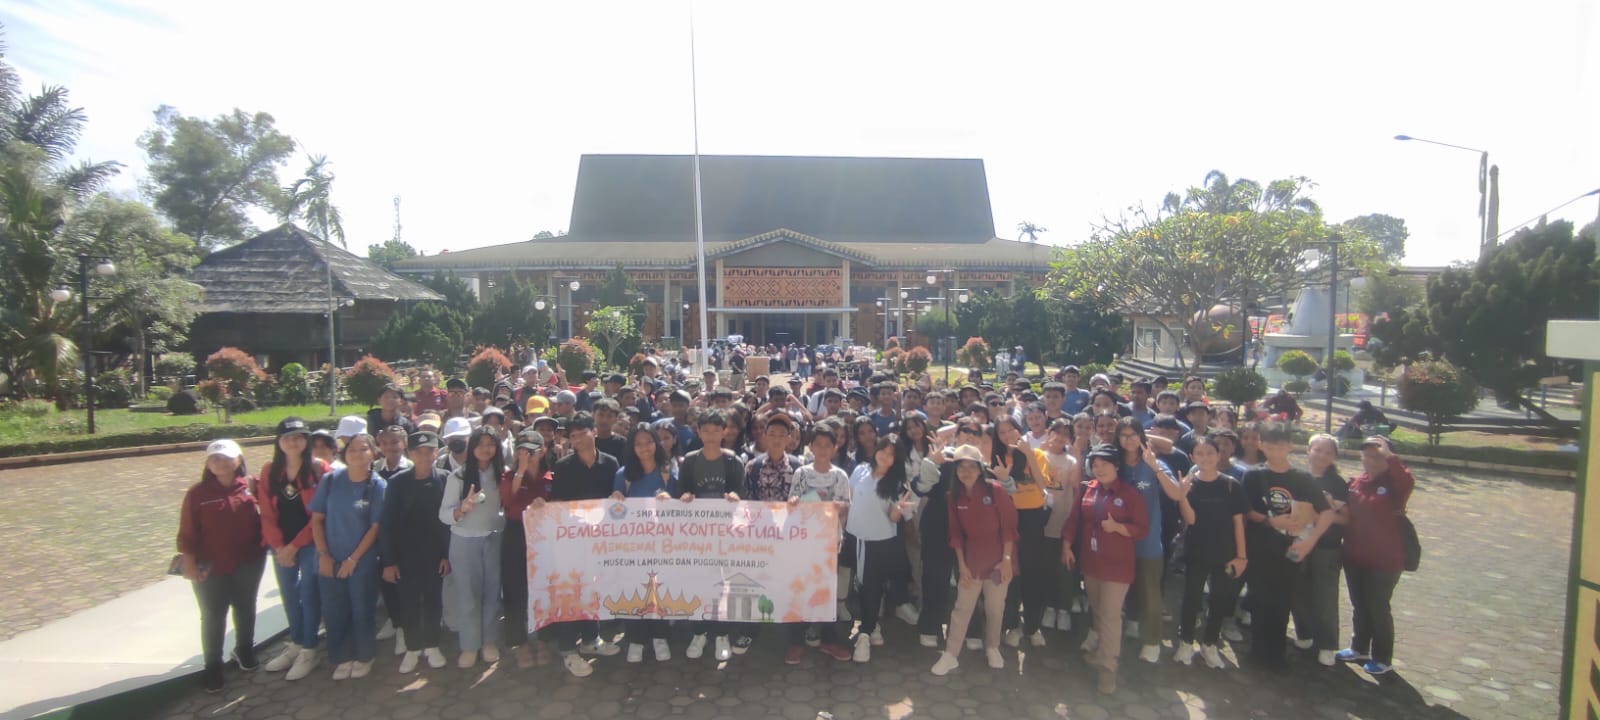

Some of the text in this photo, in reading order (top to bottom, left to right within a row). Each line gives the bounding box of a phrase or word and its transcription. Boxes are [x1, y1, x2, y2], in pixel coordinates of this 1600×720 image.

[636, 509, 653, 518] SMP
[656, 509, 693, 518] XAVERIUS
[556, 521, 808, 541] PEMBELAJARAN KONTEKSTUAL P5
[603, 558, 635, 567] MUSEUM
[637, 558, 674, 567] LAMPUNG
[675, 558, 692, 566] DAN
[693, 558, 729, 567] PUGGUNG
